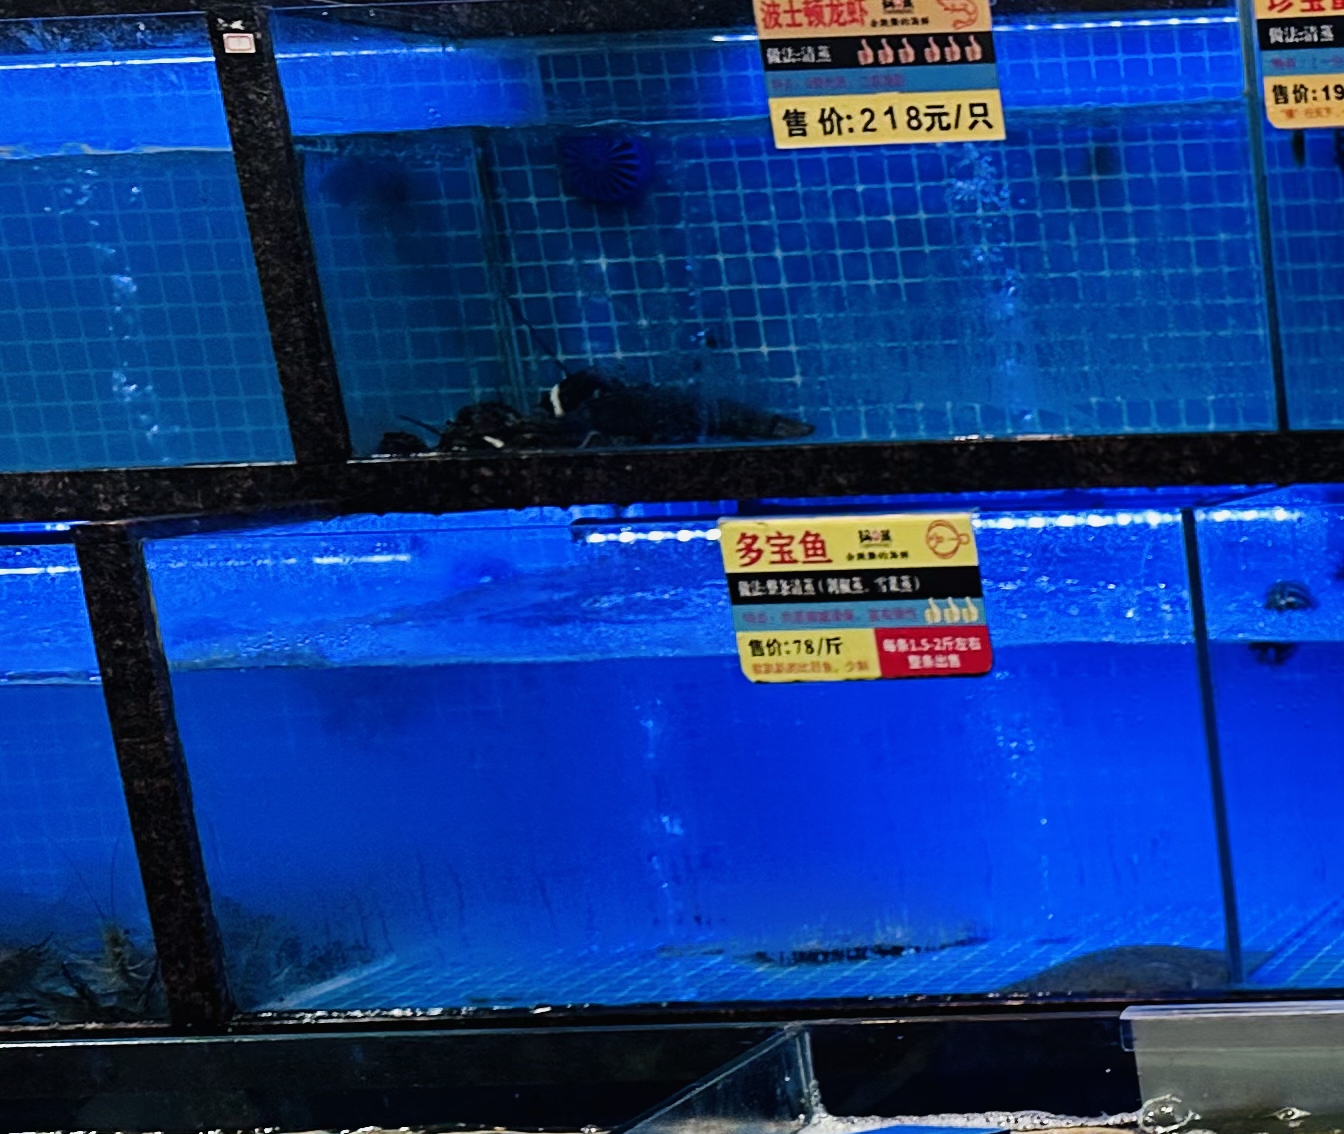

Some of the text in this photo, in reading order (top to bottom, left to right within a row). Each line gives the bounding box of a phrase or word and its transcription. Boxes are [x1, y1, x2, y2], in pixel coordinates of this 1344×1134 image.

[782, 102, 993, 138] 售价:218元/只
[735, 530, 833, 567] 多宝鱼
[748, 636, 843, 658] 售价:78/斤
